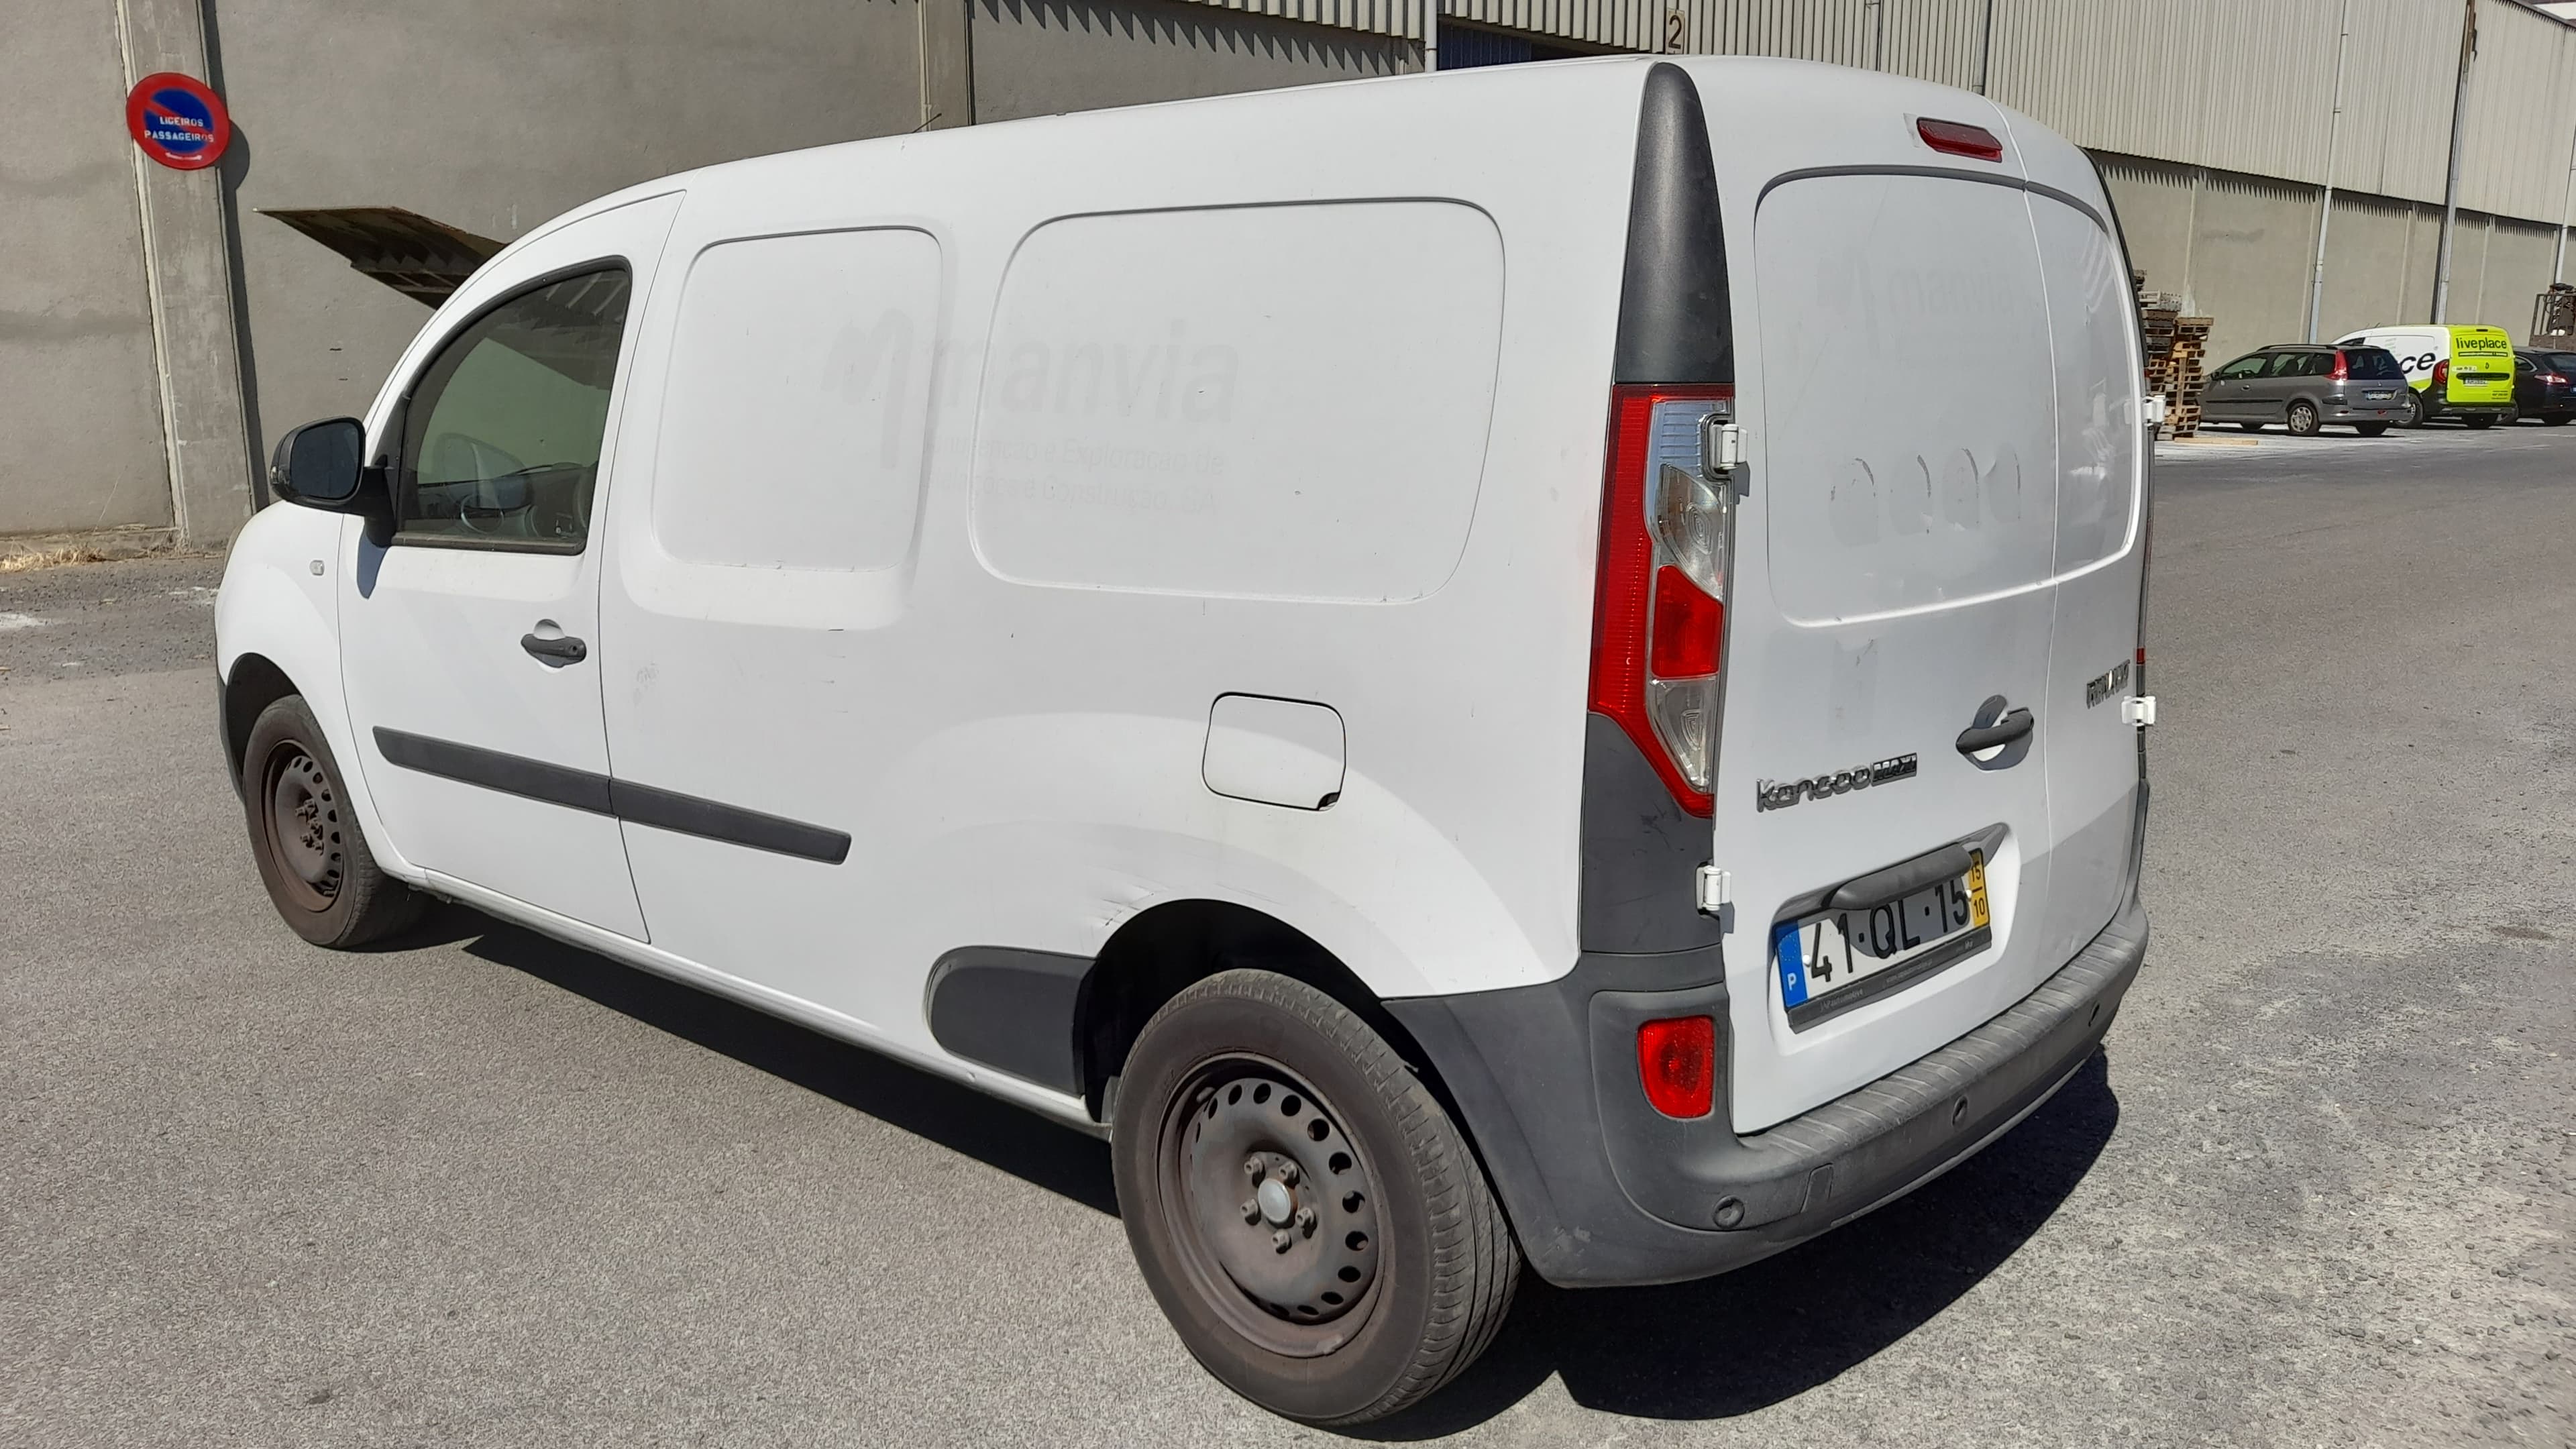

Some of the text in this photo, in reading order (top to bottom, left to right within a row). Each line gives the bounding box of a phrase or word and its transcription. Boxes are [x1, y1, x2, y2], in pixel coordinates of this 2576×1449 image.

[1668, 15, 1682, 50] 2
[160, 117, 204, 127] LIGEIROS
[144, 130, 214, 142] PASSAGEIROS
[2456, 337, 2507, 350] liveplace
[1971, 861, 1982, 882] 15
[1974, 897, 1986, 918] 10
[1786, 972, 1797, 991] P
